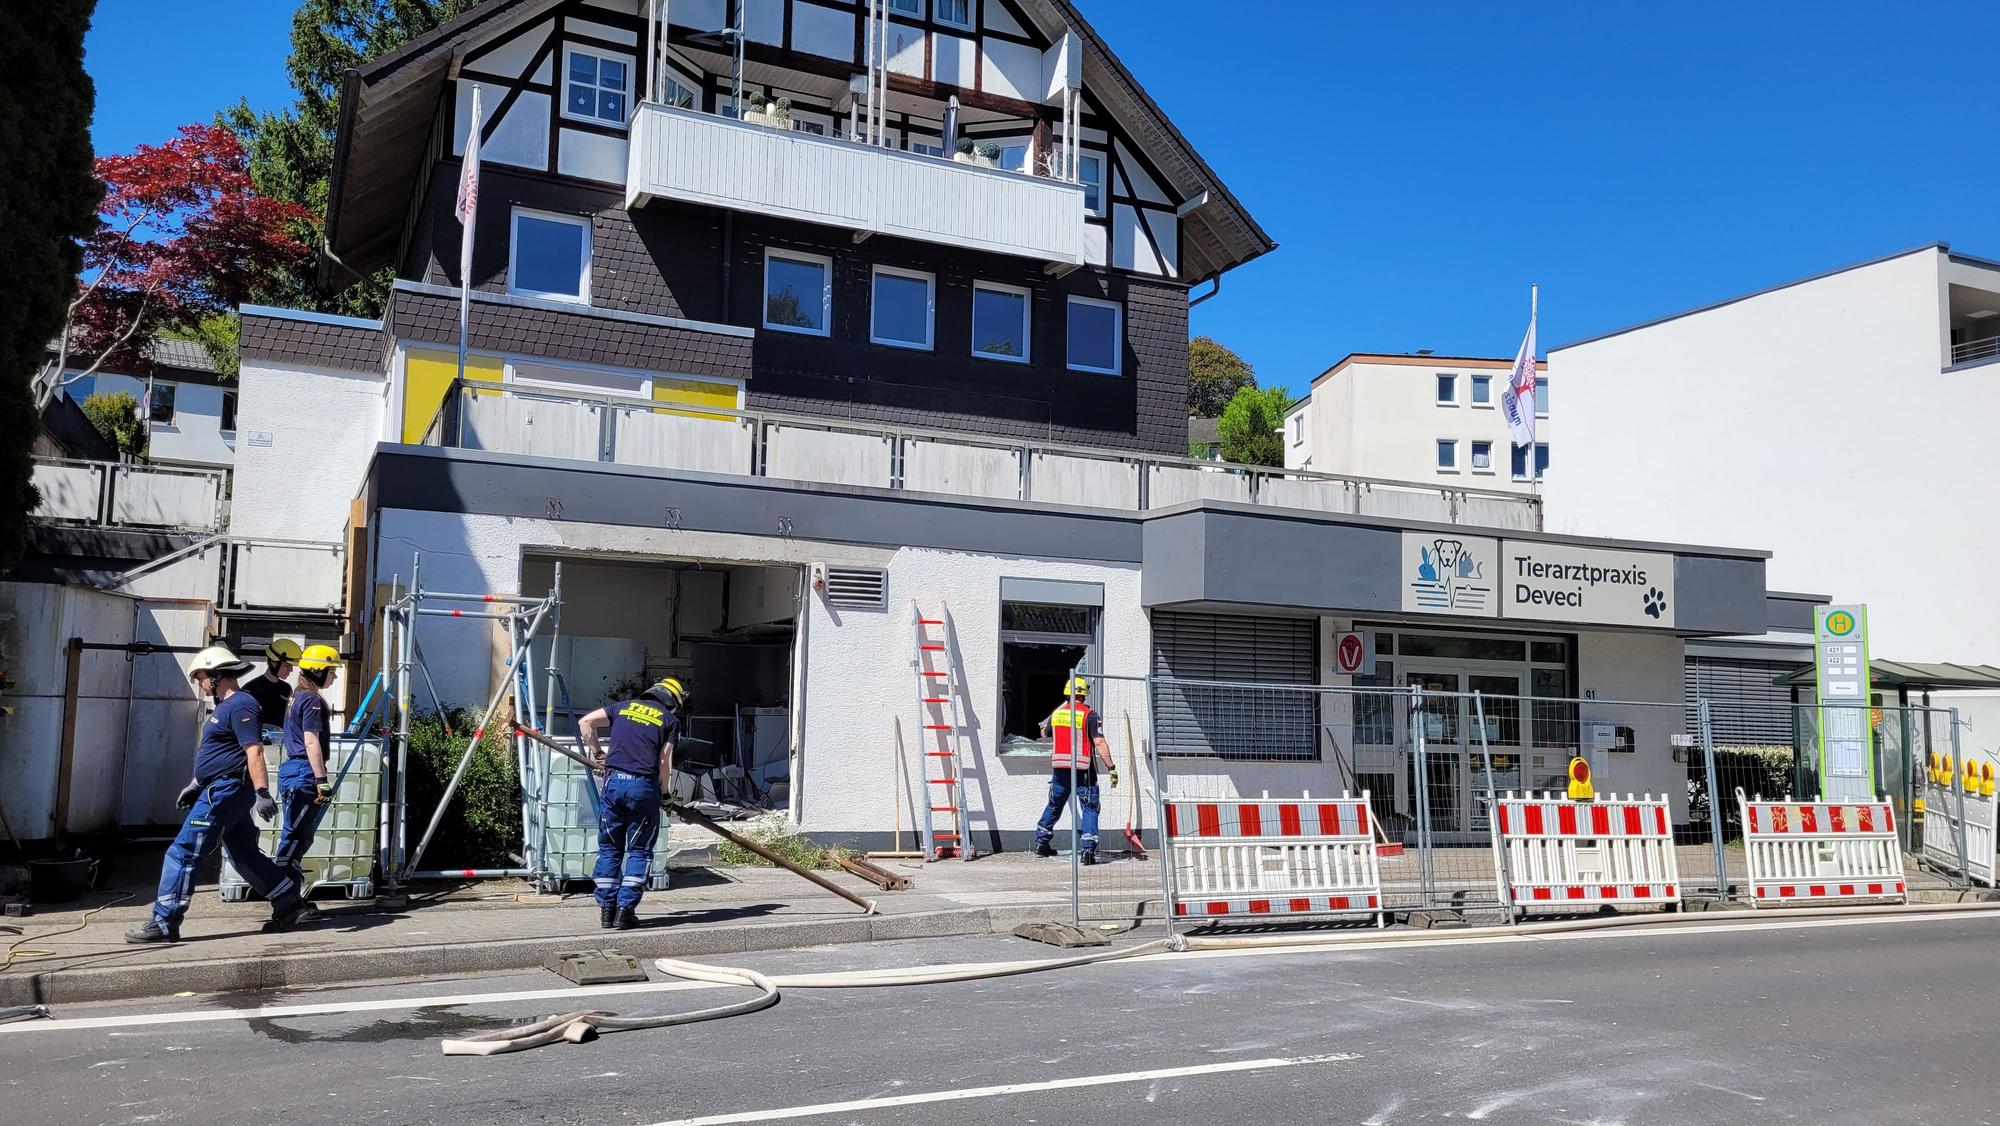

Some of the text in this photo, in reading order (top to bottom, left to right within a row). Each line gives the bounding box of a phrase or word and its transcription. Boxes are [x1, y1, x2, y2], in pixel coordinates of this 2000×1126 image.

[1514, 556, 1647, 586] Tierarztpraxis
[1515, 584, 1582, 607] Deveci
[1834, 615, 1846, 630] H
[1342, 645, 1360, 667] V
[1585, 689, 1595, 700] 91
[628, 702, 664, 718] THW
